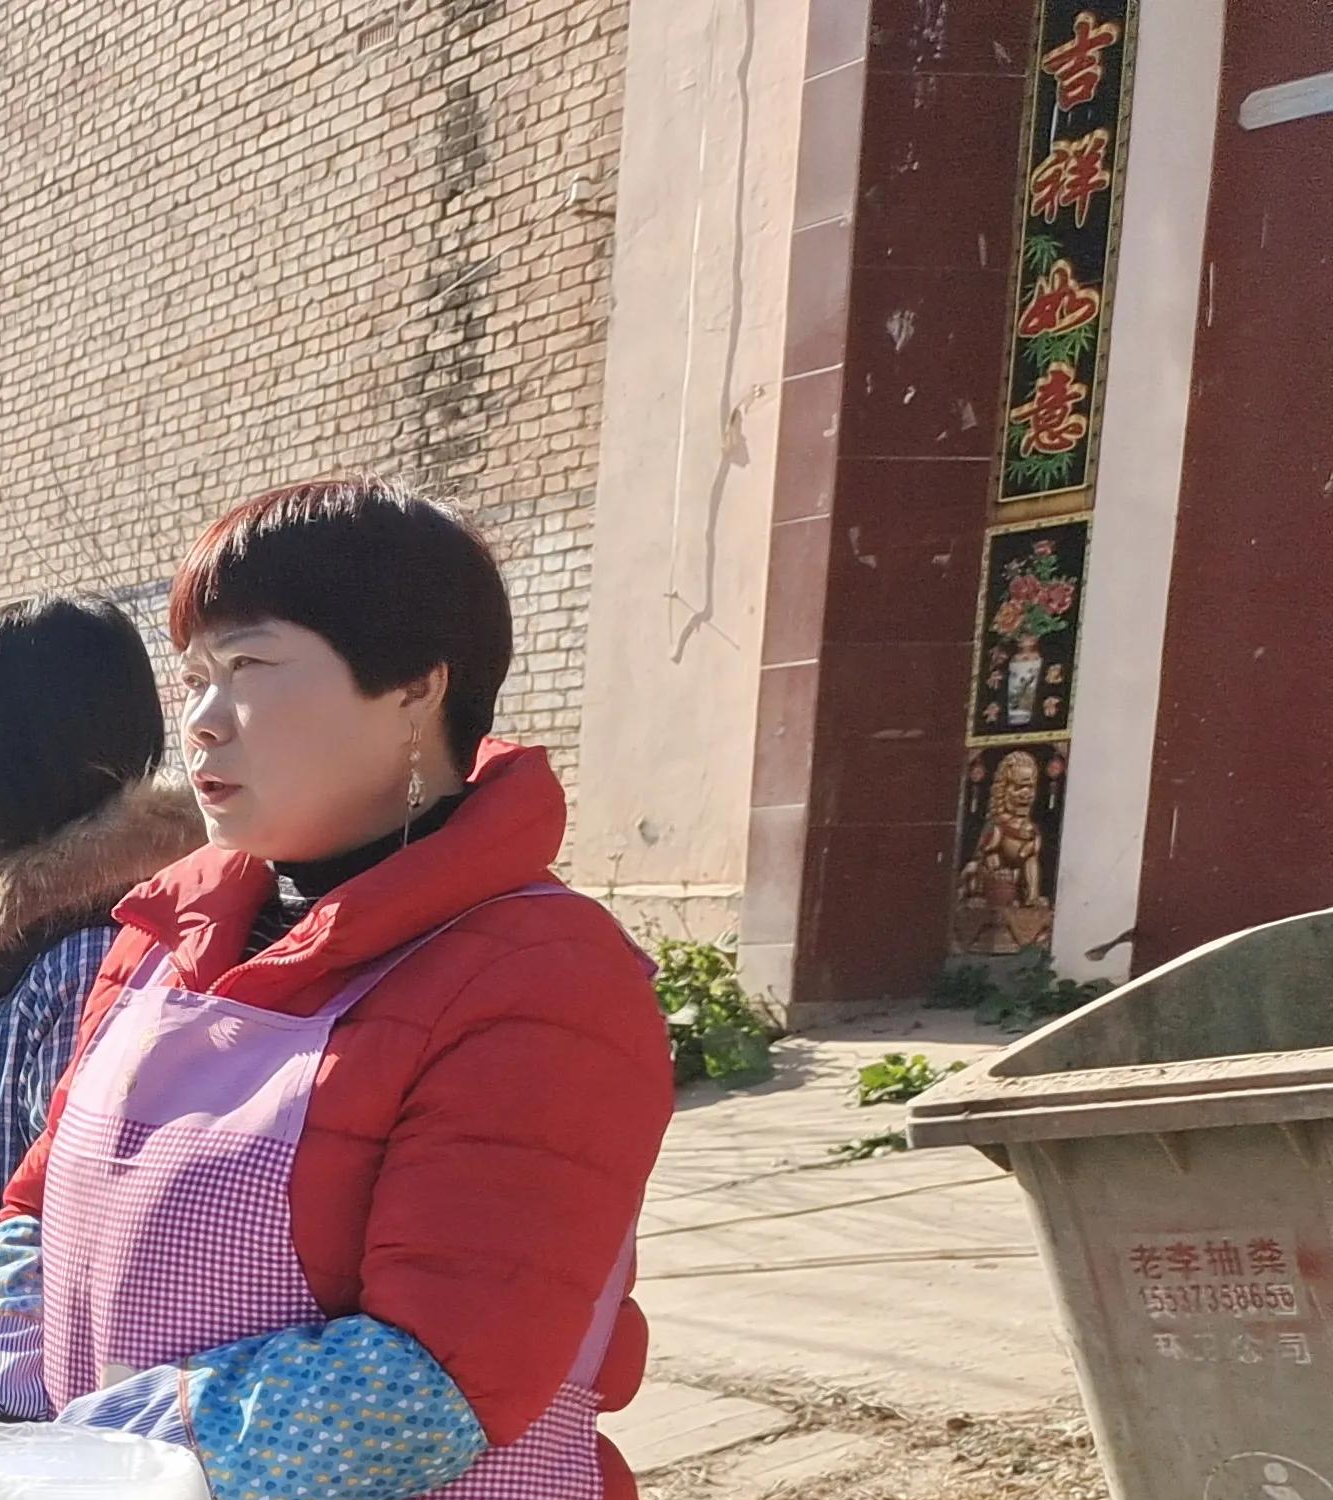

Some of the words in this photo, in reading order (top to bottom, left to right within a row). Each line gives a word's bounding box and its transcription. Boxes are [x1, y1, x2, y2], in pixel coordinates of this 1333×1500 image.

[1010, 10, 1121, 458] 吉祥如意
[1129, 1237, 1287, 1280] 老李抽粪
